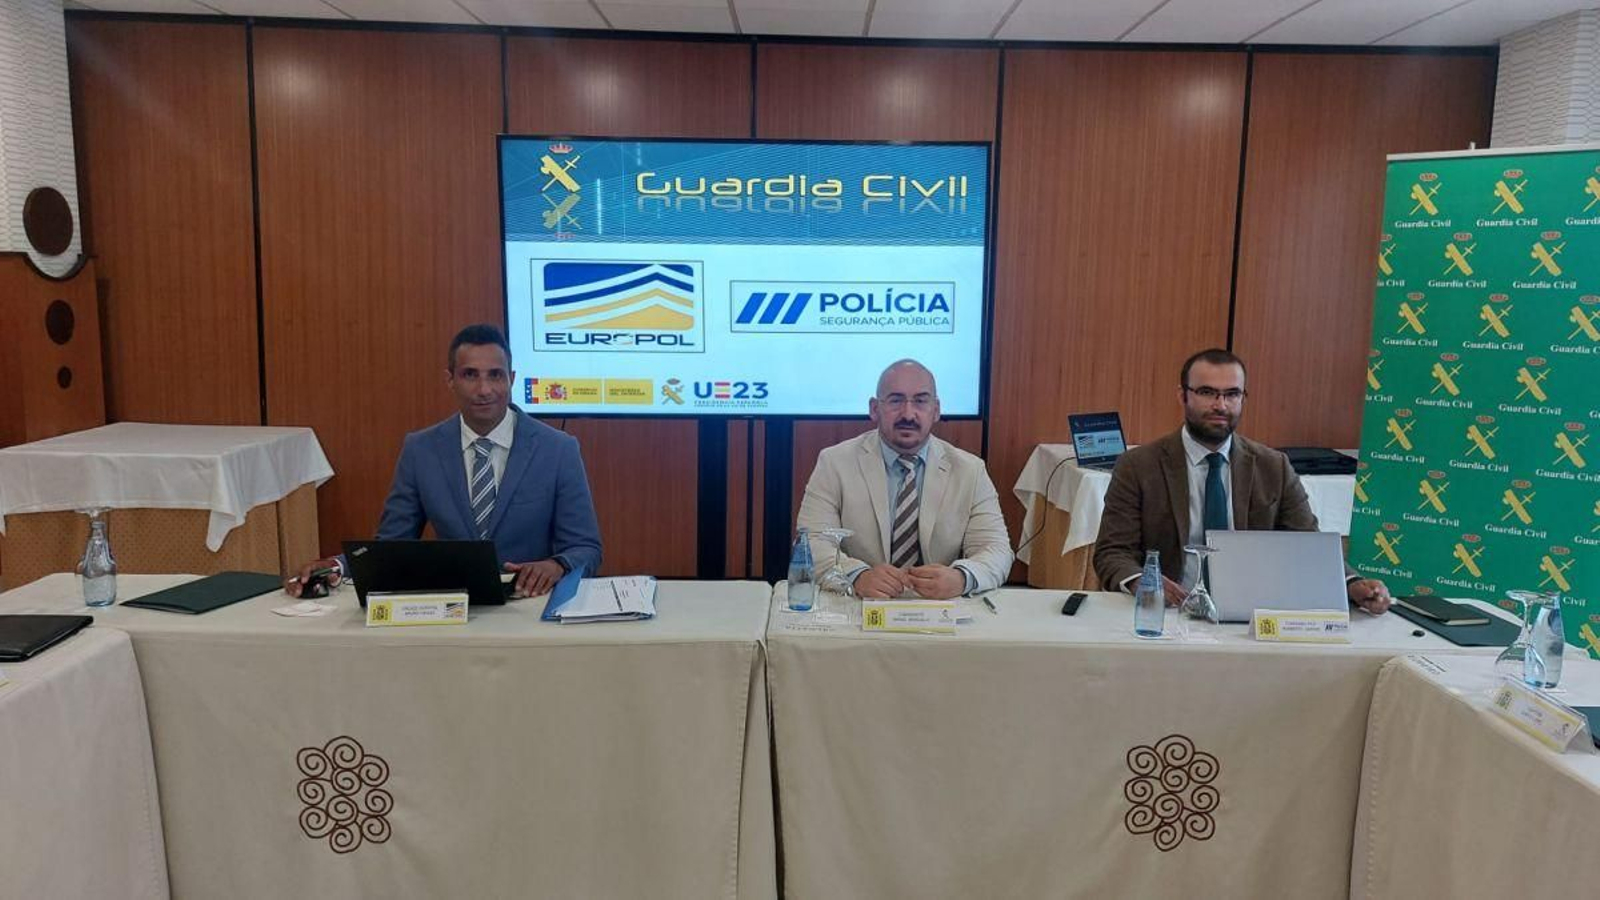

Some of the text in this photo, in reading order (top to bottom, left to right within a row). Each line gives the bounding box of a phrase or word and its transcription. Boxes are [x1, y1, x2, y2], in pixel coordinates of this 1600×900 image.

[636, 172, 968, 198] Guardia Civil
[1394, 219, 1451, 228] Guardia Civil
[1476, 218, 1538, 228] Guardia Civil
[1565, 216, 1600, 226] Guardi
[1428, 279, 1486, 288] Guardia Civil
[1512, 280, 1576, 290] Guardia Civil
[820, 288, 950, 313] POLÍCIA
[820, 314, 950, 328] SEGURANÇA PÚBLICA
[545, 332, 694, 347] EUROPOL
[1382, 337, 1438, 348] Guardia Civil
[1462, 340, 1524, 351] Guardia Civil
[1550, 344, 1590, 354] Guardia
[1416, 397, 1473, 409] Guardia Civil
[1499, 404, 1562, 416] Guardia Civil
[1370, 451, 1425, 464] Guardia Civil
[1449, 459, 1509, 472] Guardia Civil
[1536, 468, 1574, 480] Guardia
[1402, 512, 1460, 527] Guardia Civil
[1484, 523, 1547, 539] Guardia Civil
[1358, 564, 1412, 579] Guardia Civil
[1436, 576, 1496, 592] Guardia Civil
[1563, 596, 1586, 607] Civil
